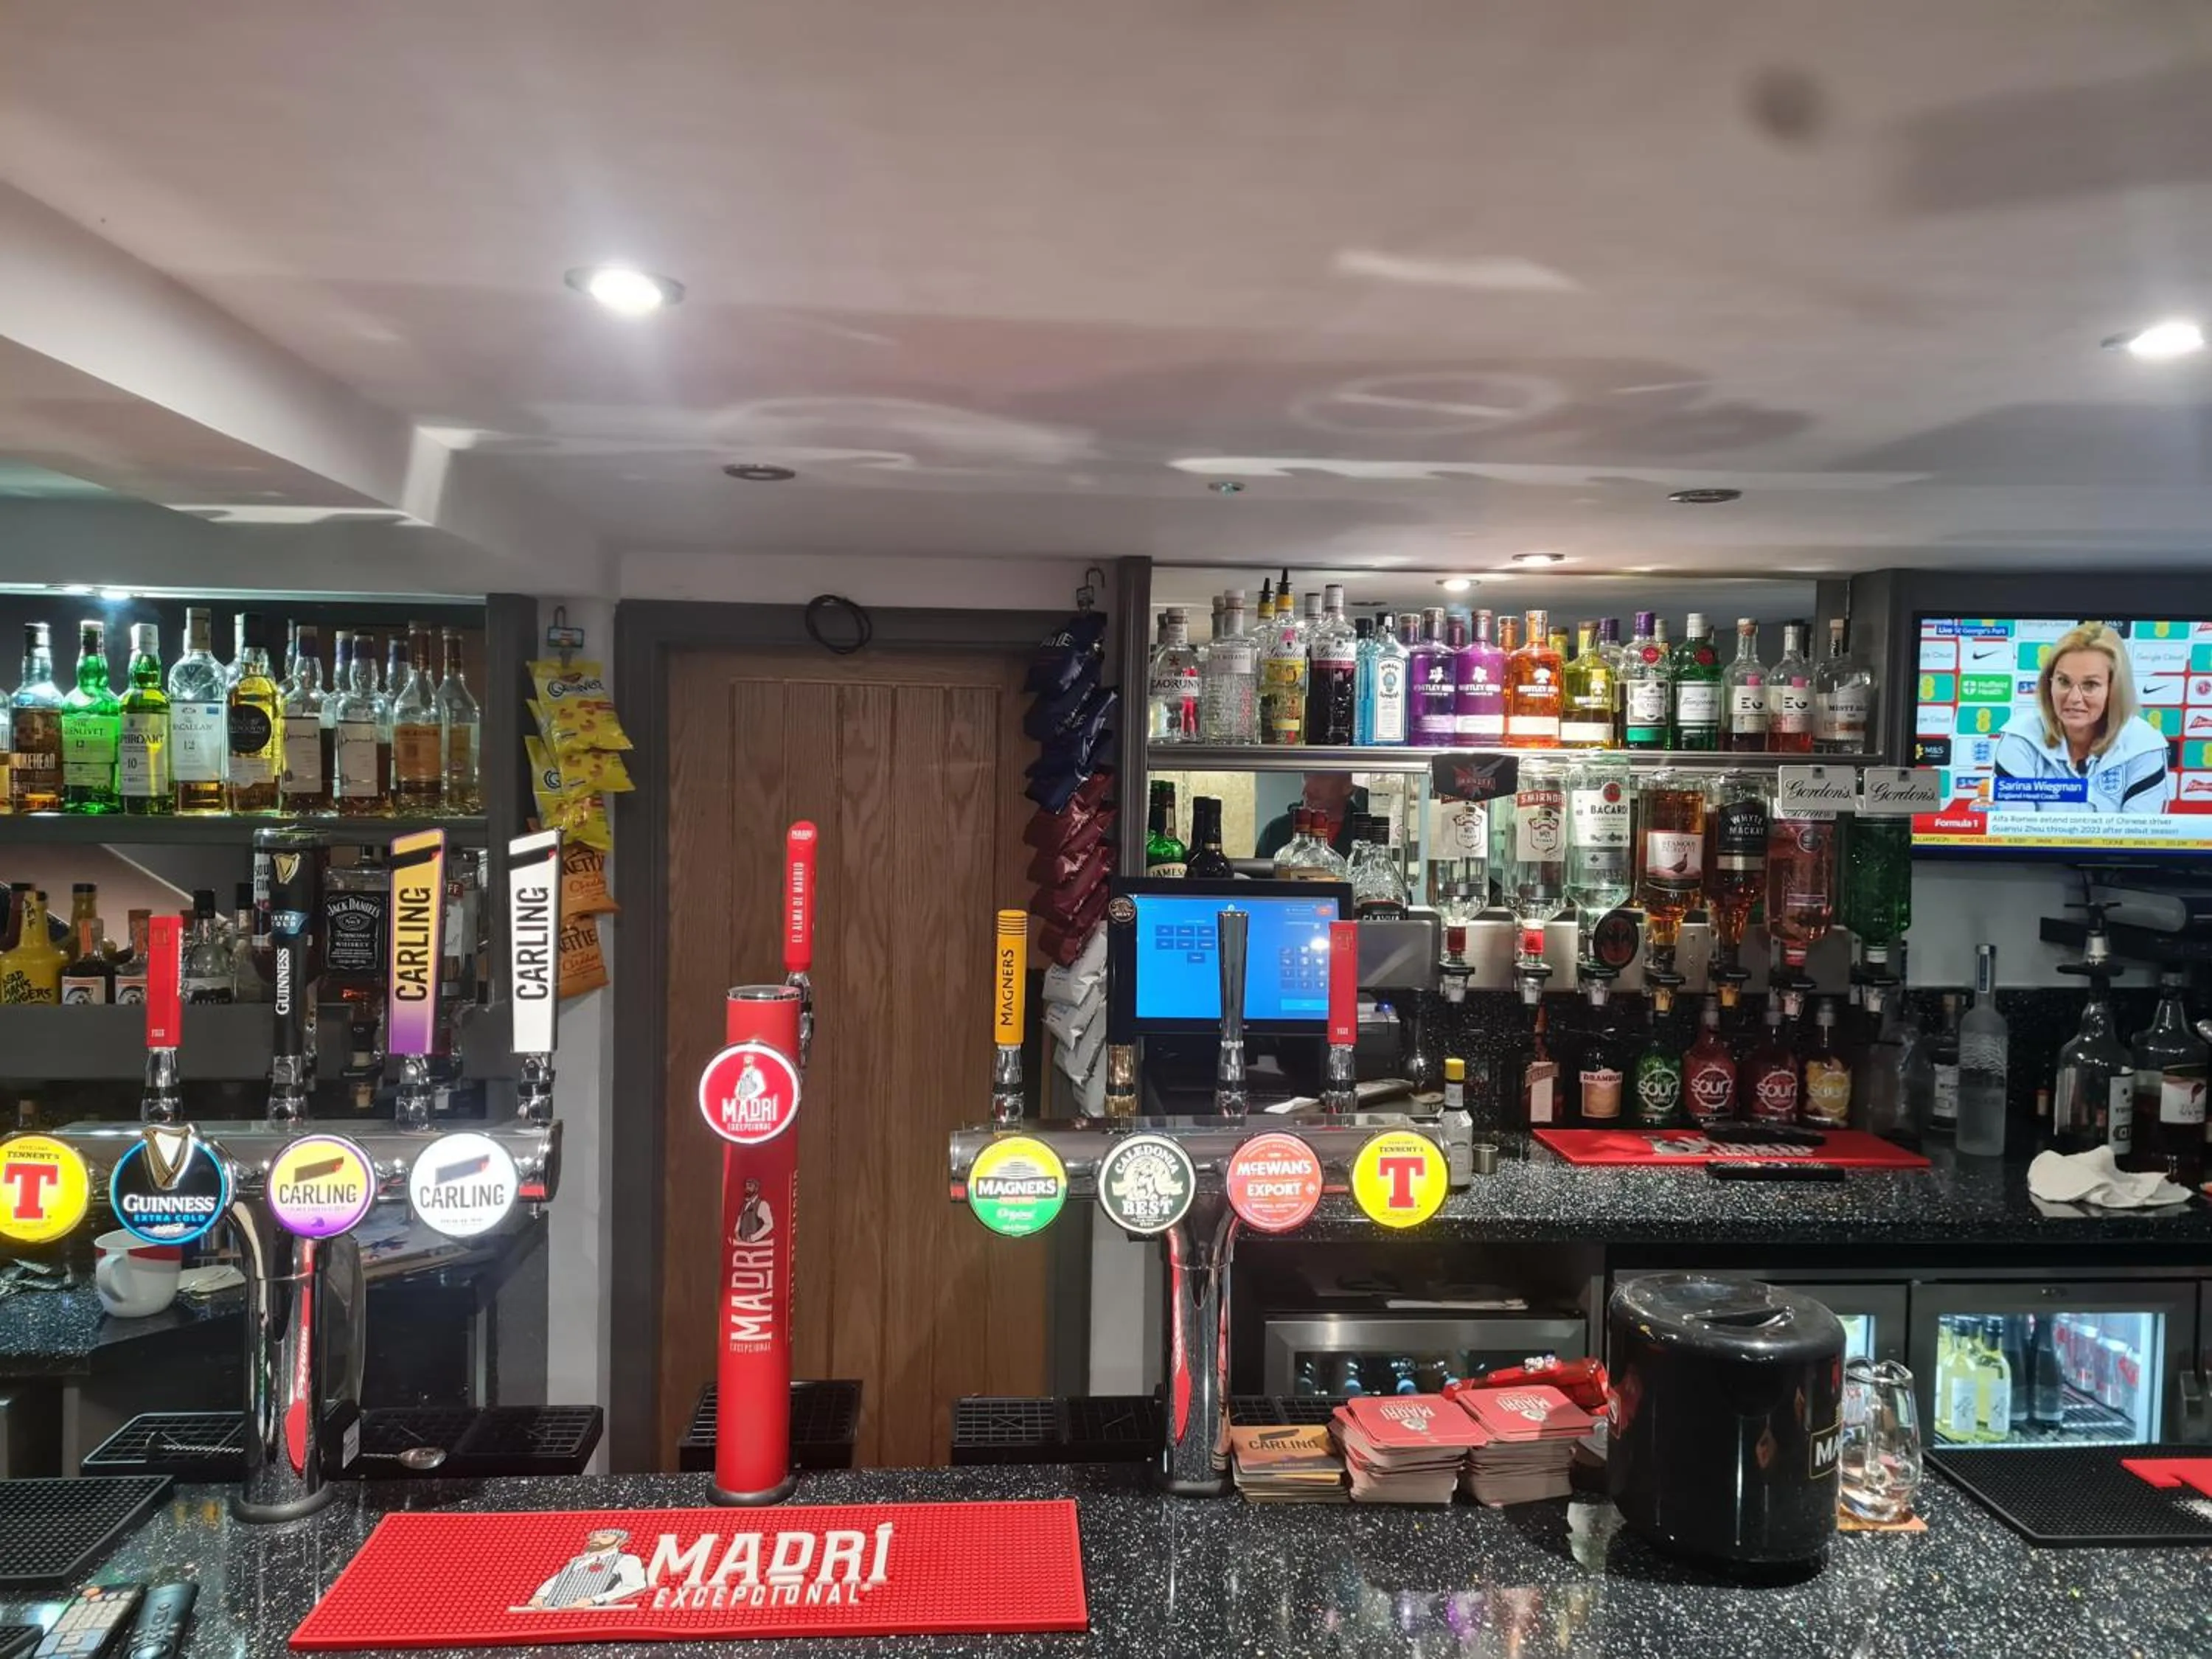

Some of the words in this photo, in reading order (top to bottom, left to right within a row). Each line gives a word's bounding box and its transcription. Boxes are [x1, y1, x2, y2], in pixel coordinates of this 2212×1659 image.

[128, 757, 137, 769] 10
[1999, 780, 2032, 791] Sarina
[2034, 781, 2082, 795] Wiegman
[1935, 818, 1972, 828] Formula
[327, 900, 349, 917] JACK
[395, 886, 431, 1002] CARLING
[515, 886, 549, 1001] CARLING
[275, 947, 290, 1015] GUINNESS
[1000, 948, 1015, 1026] MAGNERS
[720, 1093, 779, 1122] MADRÍ
[7, 1150, 60, 1160] TENNENT'S
[1114, 1144, 1179, 1175] CALEDONIA
[4, 1163, 58, 1219] T
[279, 1183, 357, 1205] CARLING
[978, 1178, 1057, 1195] MAGNERS
[1247, 1182, 1302, 1197] EXPORT
[1380, 1157, 1425, 1208] T
[122, 1193, 216, 1212] GUINNESS
[420, 1183, 505, 1209] CARLING
[1121, 1198, 1174, 1216] BEST
[133, 1214, 171, 1222] EXTRA
[728, 1237, 775, 1342] MADRÍ
[647, 1521, 894, 1588] MADRÍ
[653, 1583, 863, 1610] EXCEPCIONAL
